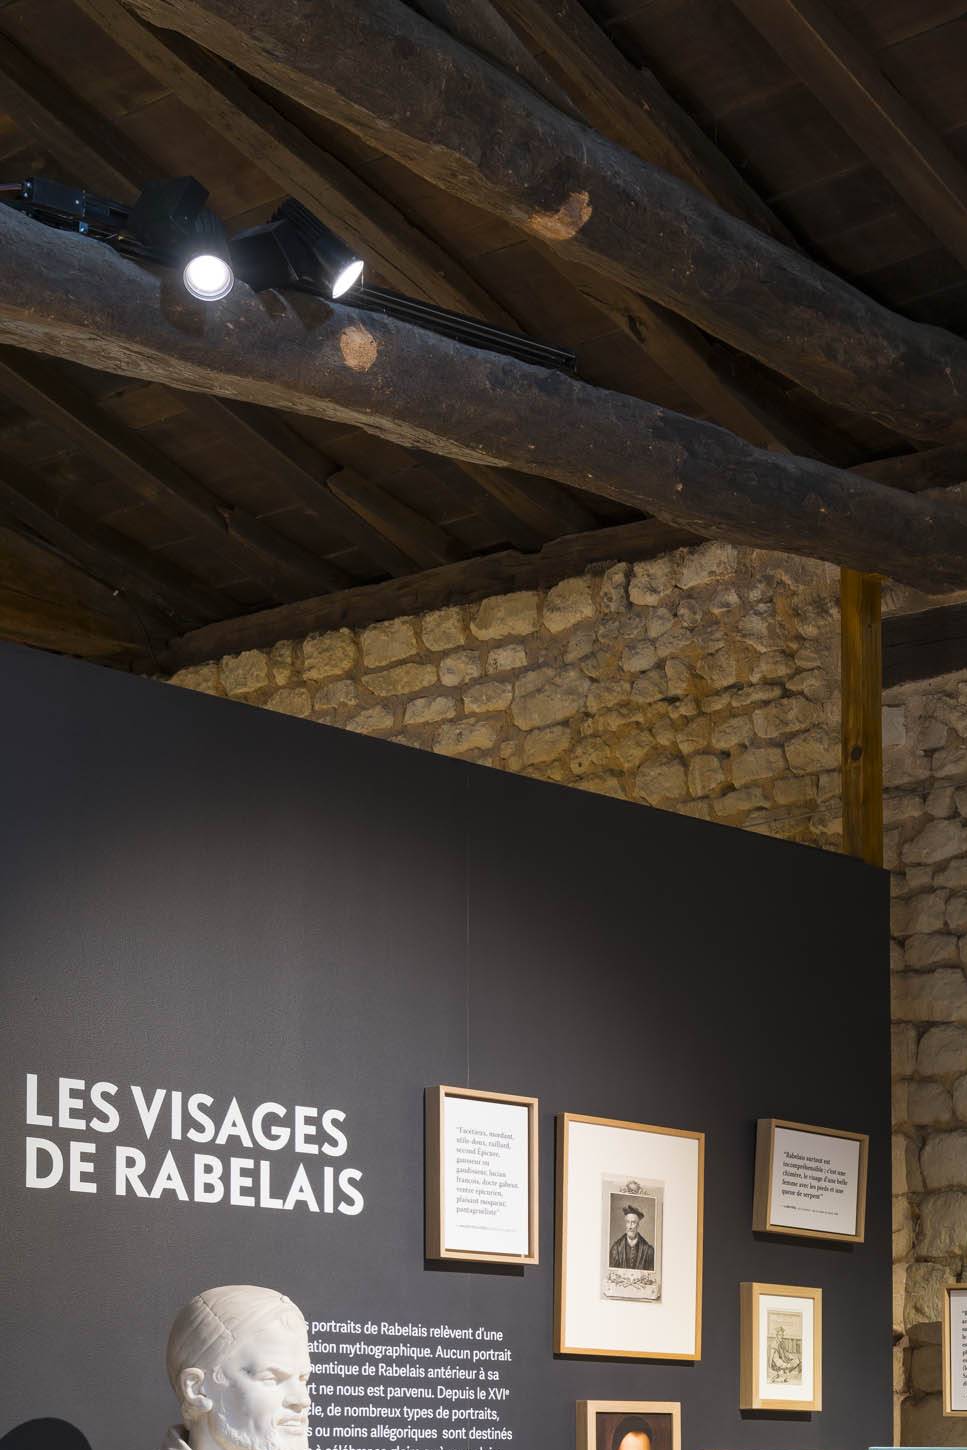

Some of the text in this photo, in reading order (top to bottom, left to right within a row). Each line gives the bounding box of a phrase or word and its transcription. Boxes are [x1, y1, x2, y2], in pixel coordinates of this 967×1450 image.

[26, 1073, 348, 1157] LES VISAGES
[26, 1137, 364, 1216] DE RABELAIS
[312, 1320, 361, 1334] portraits
[364, 1321, 378, 1334] de
[381, 1322, 427, 1337] Rabelais
[430, 1325, 473, 1339] relèvent
[475, 1327, 503, 1341] d'une
[339, 1341, 433, 1360] mythographique.
[435, 1345, 470, 1359] Aucun
[473, 1349, 512, 1363] portrait
[362, 1362, 376, 1376] de
[379, 1363, 425, 1377] Rabelais
[427, 1366, 477, 1379] antérieur
[479, 1367, 485, 1380] à
[488, 1371, 499, 1380] sa
[319, 1385, 334, 1395] ne
[337, 1386, 365, 1396] nous
[367, 1385, 385, 1396] est
[387, 1387, 434, 1400] parvenu.
[437, 1386, 475, 1402] Depuis
[477, 1387, 486, 1400] le
[327, 1403, 342, 1416] de
[344, 1404, 401, 1417] nombreux
[403, 1406, 433, 1421] types
[436, 1406, 449, 1419] de
[452, 1407, 499, 1422] portraits,
[315, 1427, 330, 1437] ou
[333, 1424, 368, 1437] moins
[370, 1424, 437, 1441] allégoriques
[442, 1428, 466, 1439] sont
[469, 1427, 512, 1440] destinés
